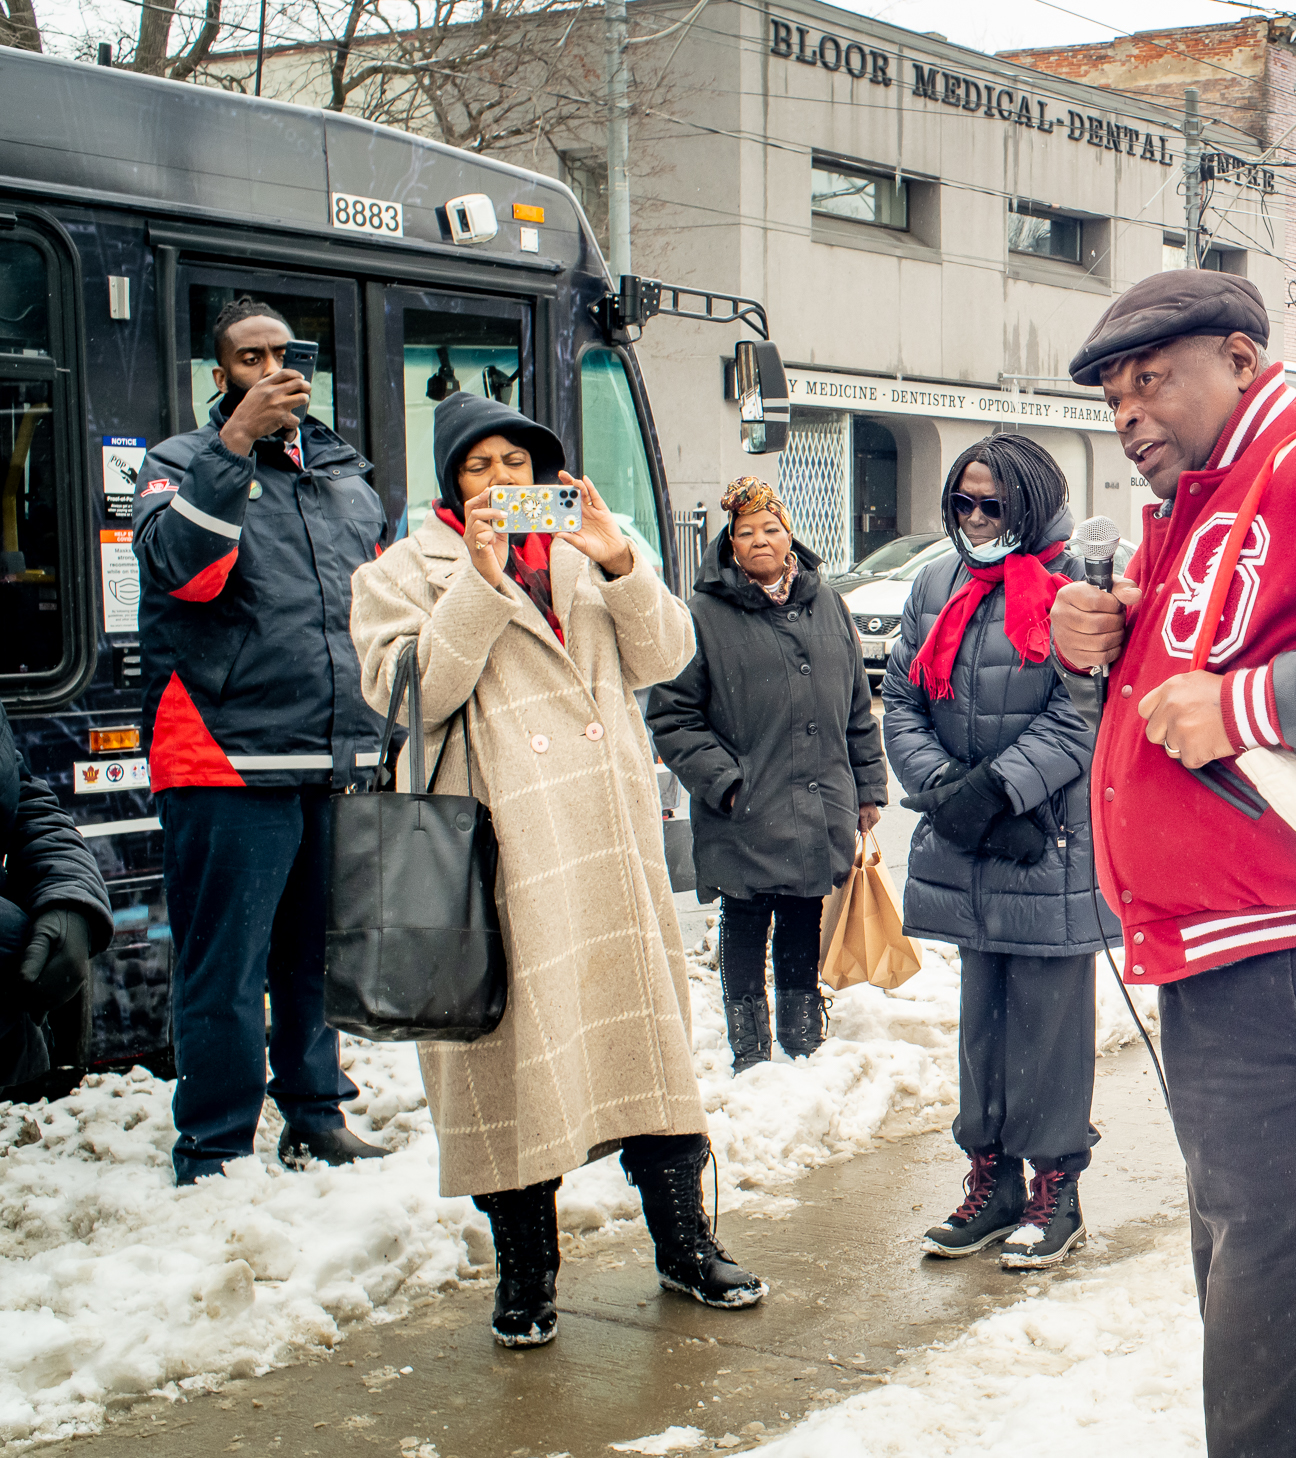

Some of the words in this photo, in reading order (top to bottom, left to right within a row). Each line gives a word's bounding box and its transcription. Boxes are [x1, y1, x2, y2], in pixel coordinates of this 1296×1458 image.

[771, 18, 892, 87] BLOOR
[912, 63, 1173, 167] MEDICAL-DENTAL
[335, 197, 400, 232] 8883
[806, 381, 877, 401] MEDICINE
[891, 389, 967, 409] DENTISTRY
[1063, 406, 1115, 423] PHARMAC
[111, 437, 137, 446] NOTICE
[110, 455, 127, 469] POP
[1130, 476, 1150, 487] BLOO
